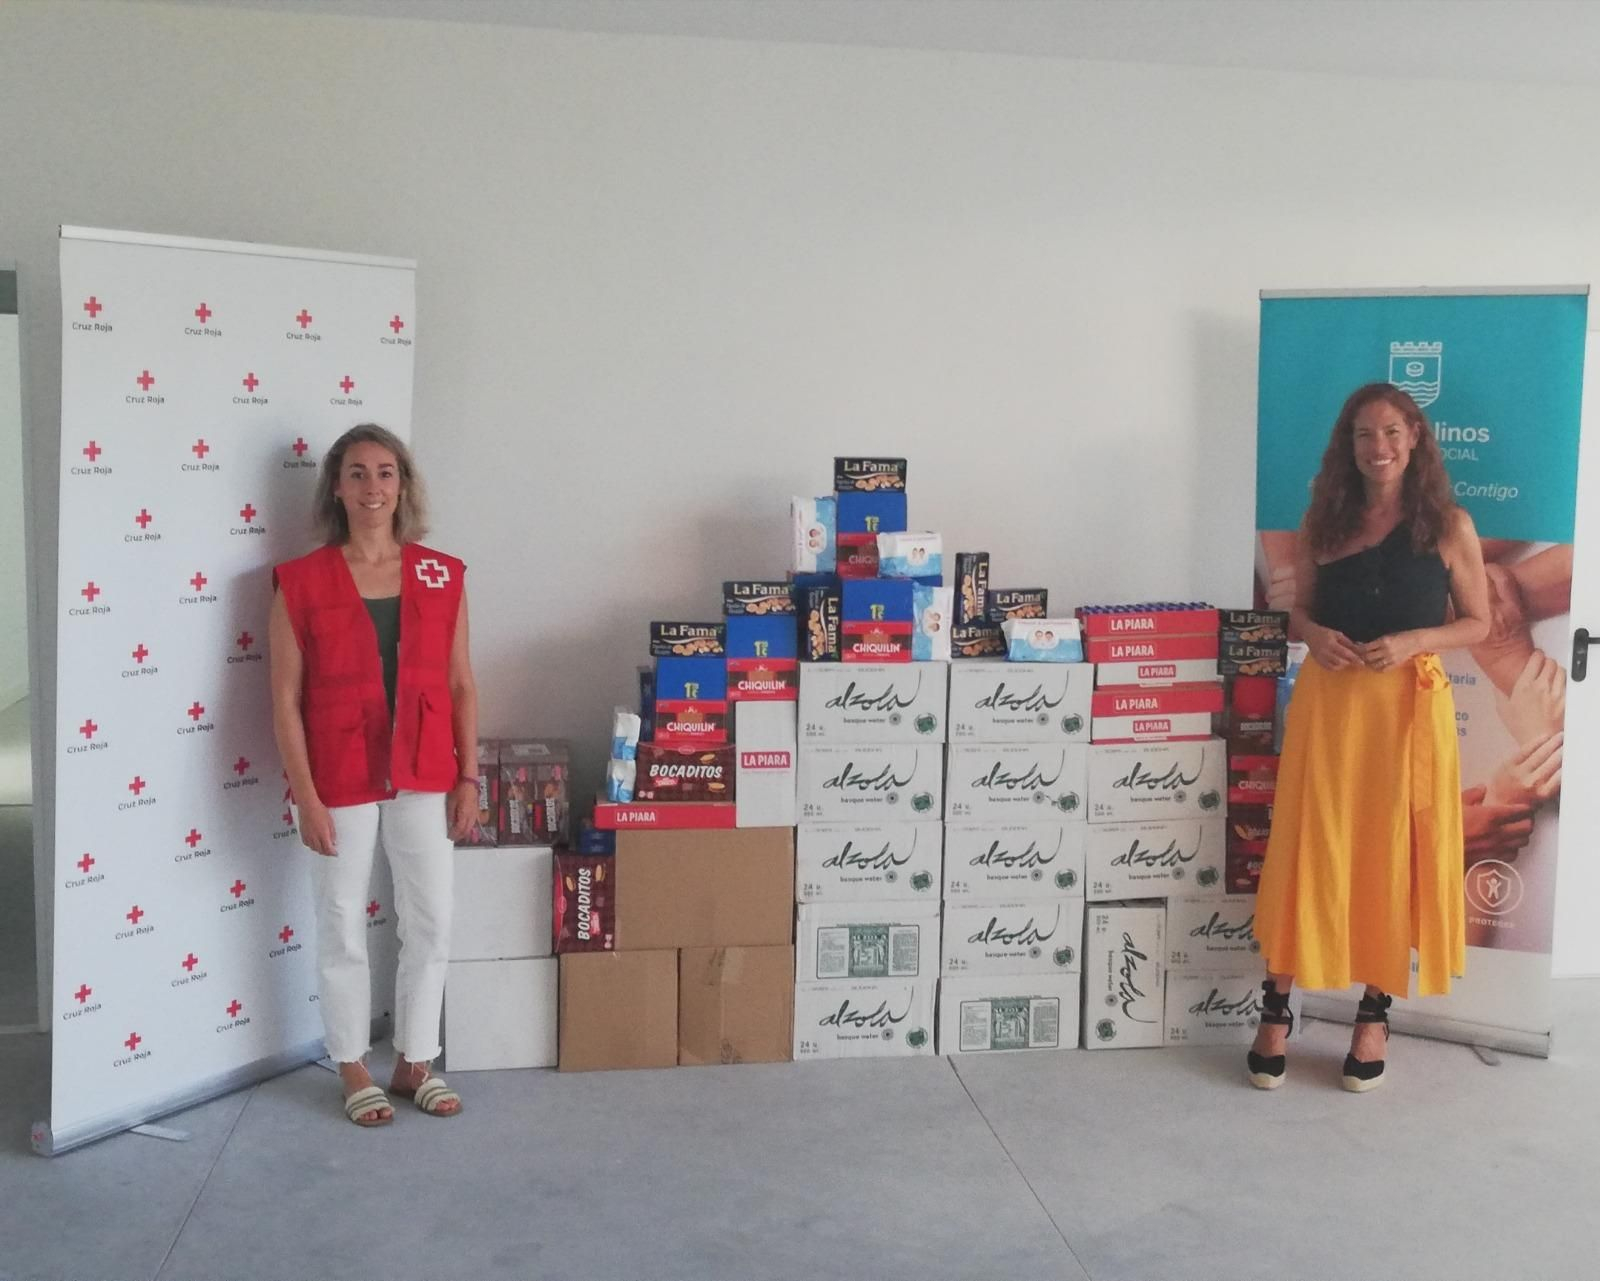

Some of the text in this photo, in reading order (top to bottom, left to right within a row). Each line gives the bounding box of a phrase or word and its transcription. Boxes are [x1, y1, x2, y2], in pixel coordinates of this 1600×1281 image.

[72, 322, 112, 332] Cruz Roja
[204, 328, 222, 337] Roja
[286, 332, 321, 342] Cruz Roja
[397, 338, 411, 346] Roja
[147, 396, 164, 405] Roja
[252, 397, 268, 405] Roja
[348, 398, 362, 406] Roja
[1434, 422, 1490, 442] linos
[71, 467, 112, 475] Cruz Roja
[202, 464, 219, 472] Roja
[844, 460, 898, 472] La Fama
[1454, 482, 1519, 502] Contigo
[145, 533, 161, 541] Roja
[249, 527, 266, 535] Roja
[734, 584, 789, 594] La Fama
[977, 562, 988, 616] La Fama
[200, 595, 216, 603] Roja
[997, 593, 1041, 603] La Fama
[92, 606, 110, 614] Roja
[1111, 618, 1154, 630] LA PIARA
[1230, 612, 1280, 624] La Fama
[660, 624, 717, 636] La Fama
[826, 597, 838, 652] La Fama
[245, 653, 262, 662] Roja
[1112, 646, 1154, 657] LA PIARA
[1229, 646, 1280, 657] La Fama
[122, 666, 158, 678] Cruz Roja
[1140, 667, 1174, 677] LA PIARA
[826, 670, 921, 712] alzola
[975, 670, 1069, 712] alzola
[1116, 698, 1158, 710] LA PIARA
[197, 724, 214, 732] Roja
[1134, 721, 1169, 731] LA PIARA
[90, 742, 108, 750] Roja
[743, 755, 788, 765] LA PIARA
[650, 764, 722, 778] BOCADITOS
[823, 749, 918, 790] alzola
[972, 749, 1065, 790] alzola
[1113, 746, 1204, 790] alzola
[118, 797, 156, 811] Cruz Roja
[617, 812, 656, 822] LA PIARA
[822, 828, 917, 869] alzola
[970, 828, 1062, 868] alzola
[1111, 825, 1201, 867] alzola
[175, 850, 210, 862] Cruz Roja
[65, 874, 104, 888] Cruz Roja
[220, 899, 254, 912] Cruz Roja
[577, 868, 591, 940] BOCADITOS
[968, 904, 1060, 945] alzola
[115, 926, 154, 940] Cruz Roja
[269, 942, 302, 958] Cruz Roja
[171, 972, 207, 987] Cruz Roja
[63, 1004, 101, 1020] Cruz Roja
[819, 986, 913, 1028] alzola
[216, 1016, 250, 1033] Cruz Roja
[113, 1049, 151, 1067] Cruz Roja
